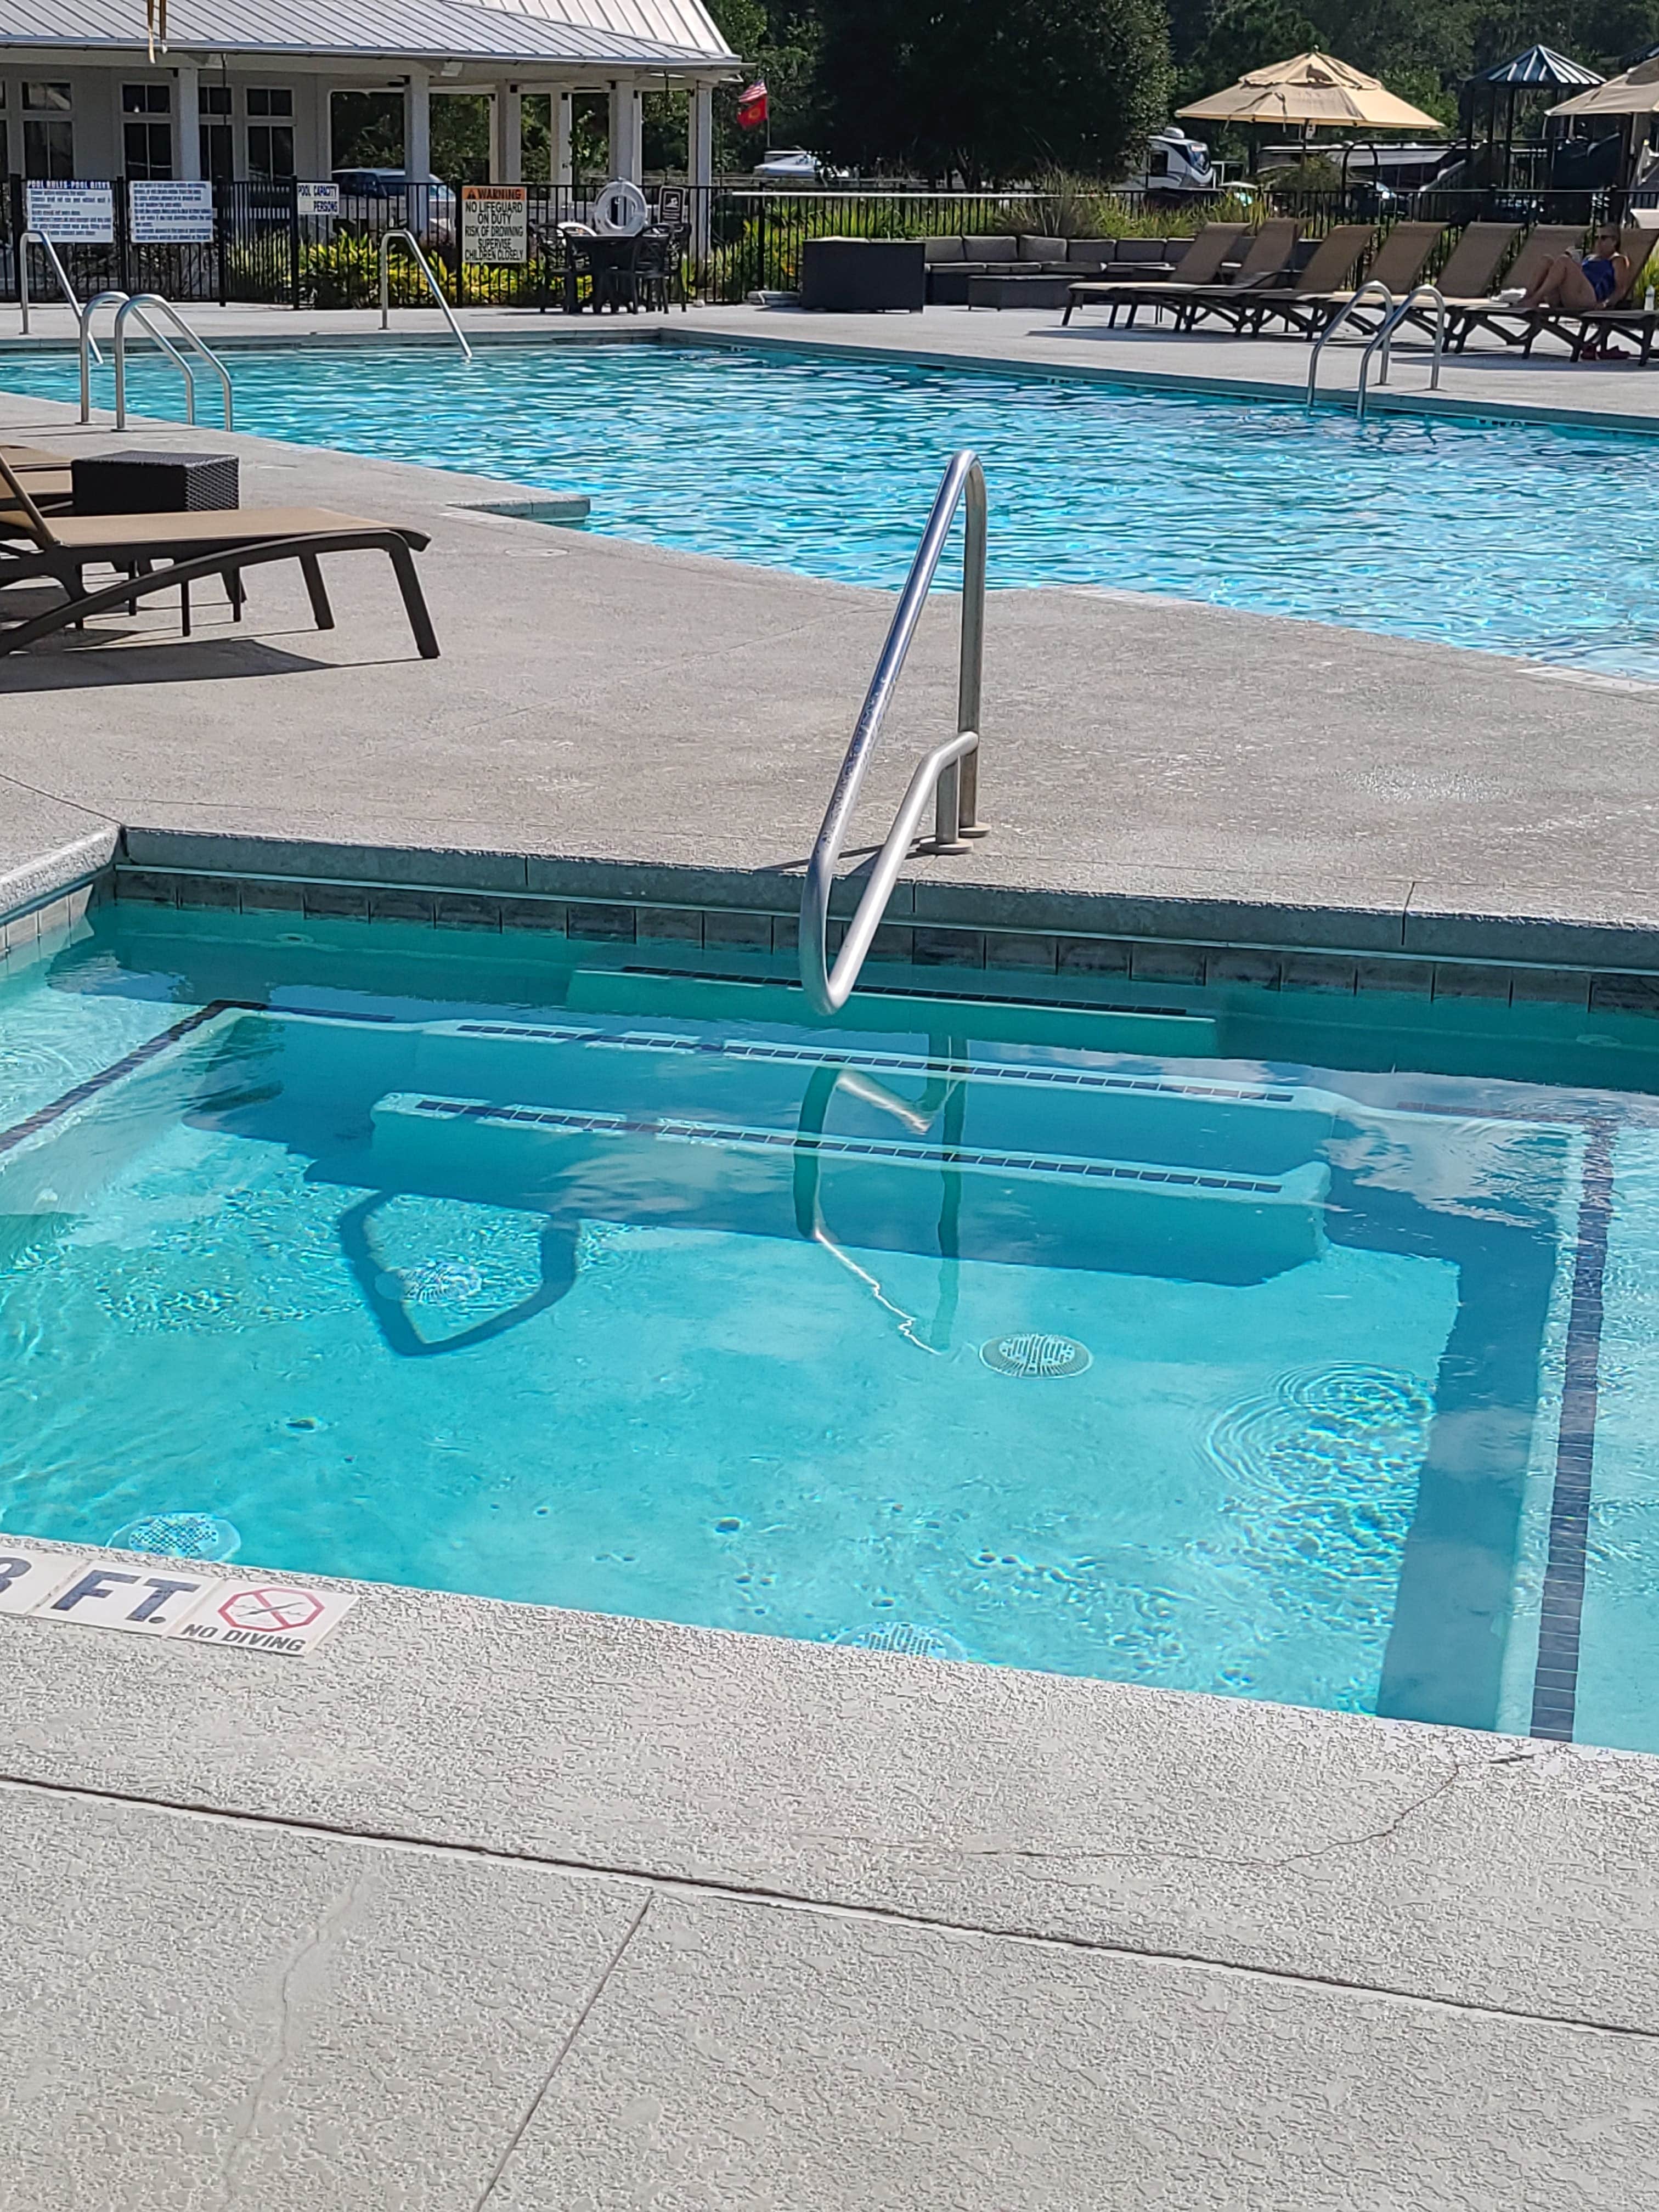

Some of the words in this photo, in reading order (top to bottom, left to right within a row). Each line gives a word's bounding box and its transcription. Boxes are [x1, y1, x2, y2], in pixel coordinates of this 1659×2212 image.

[27, 180, 43, 188] POOL
[298, 184, 311, 196] POOL
[314, 185, 337, 197] CAPACITY
[477, 188, 522, 200] WARNING
[314, 201, 337, 212] PERSONS
[465, 201, 477, 212] NO
[479, 201, 523, 213] LIFEGUARD
[478, 213, 489, 224] ON
[491, 213, 511, 224] DUTY
[465, 225, 479, 236] RISK
[481, 225, 489, 236] OF
[491, 226, 523, 236] DROWNING
[478, 238, 511, 249] SUPERVISE
[465, 249, 496, 261] CHILDREN
[498, 249, 523, 261] CLOSELY
[50, 1570, 201, 1624] FT.
[180, 1624, 218, 1638] NO
[221, 1629, 306, 1651] DIVING
